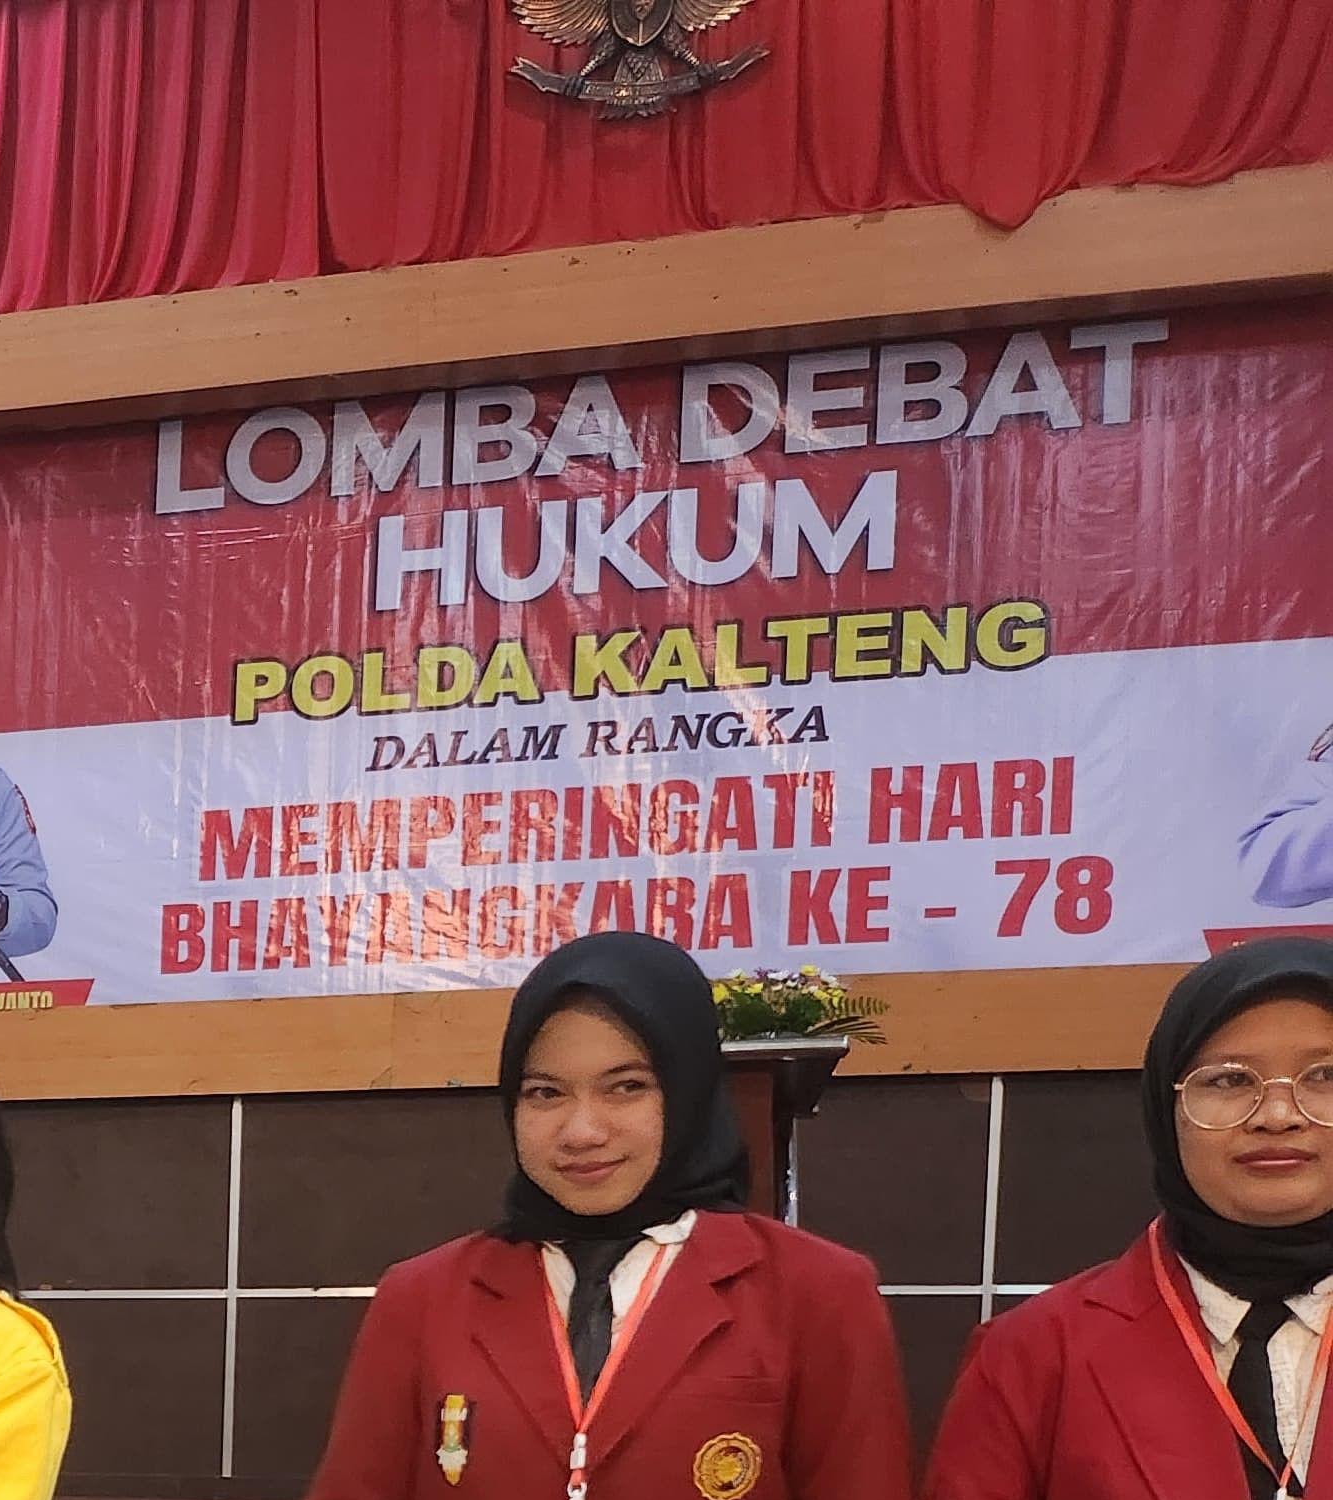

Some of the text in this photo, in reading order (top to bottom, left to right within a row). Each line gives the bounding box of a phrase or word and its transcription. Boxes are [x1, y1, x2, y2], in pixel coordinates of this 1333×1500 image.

[153, 318, 1170, 516] LOMBA DEBAT
[374, 469, 899, 613] HUKUM
[231, 601, 1052, 726] POLDA KALTENG
[364, 705, 830, 774] DALAM RANGKA
[197, 756, 1076, 881] MEMPERINGATI HARI
[786, 866, 892, 946] KE
[994, 856, 1114, 938] 78
